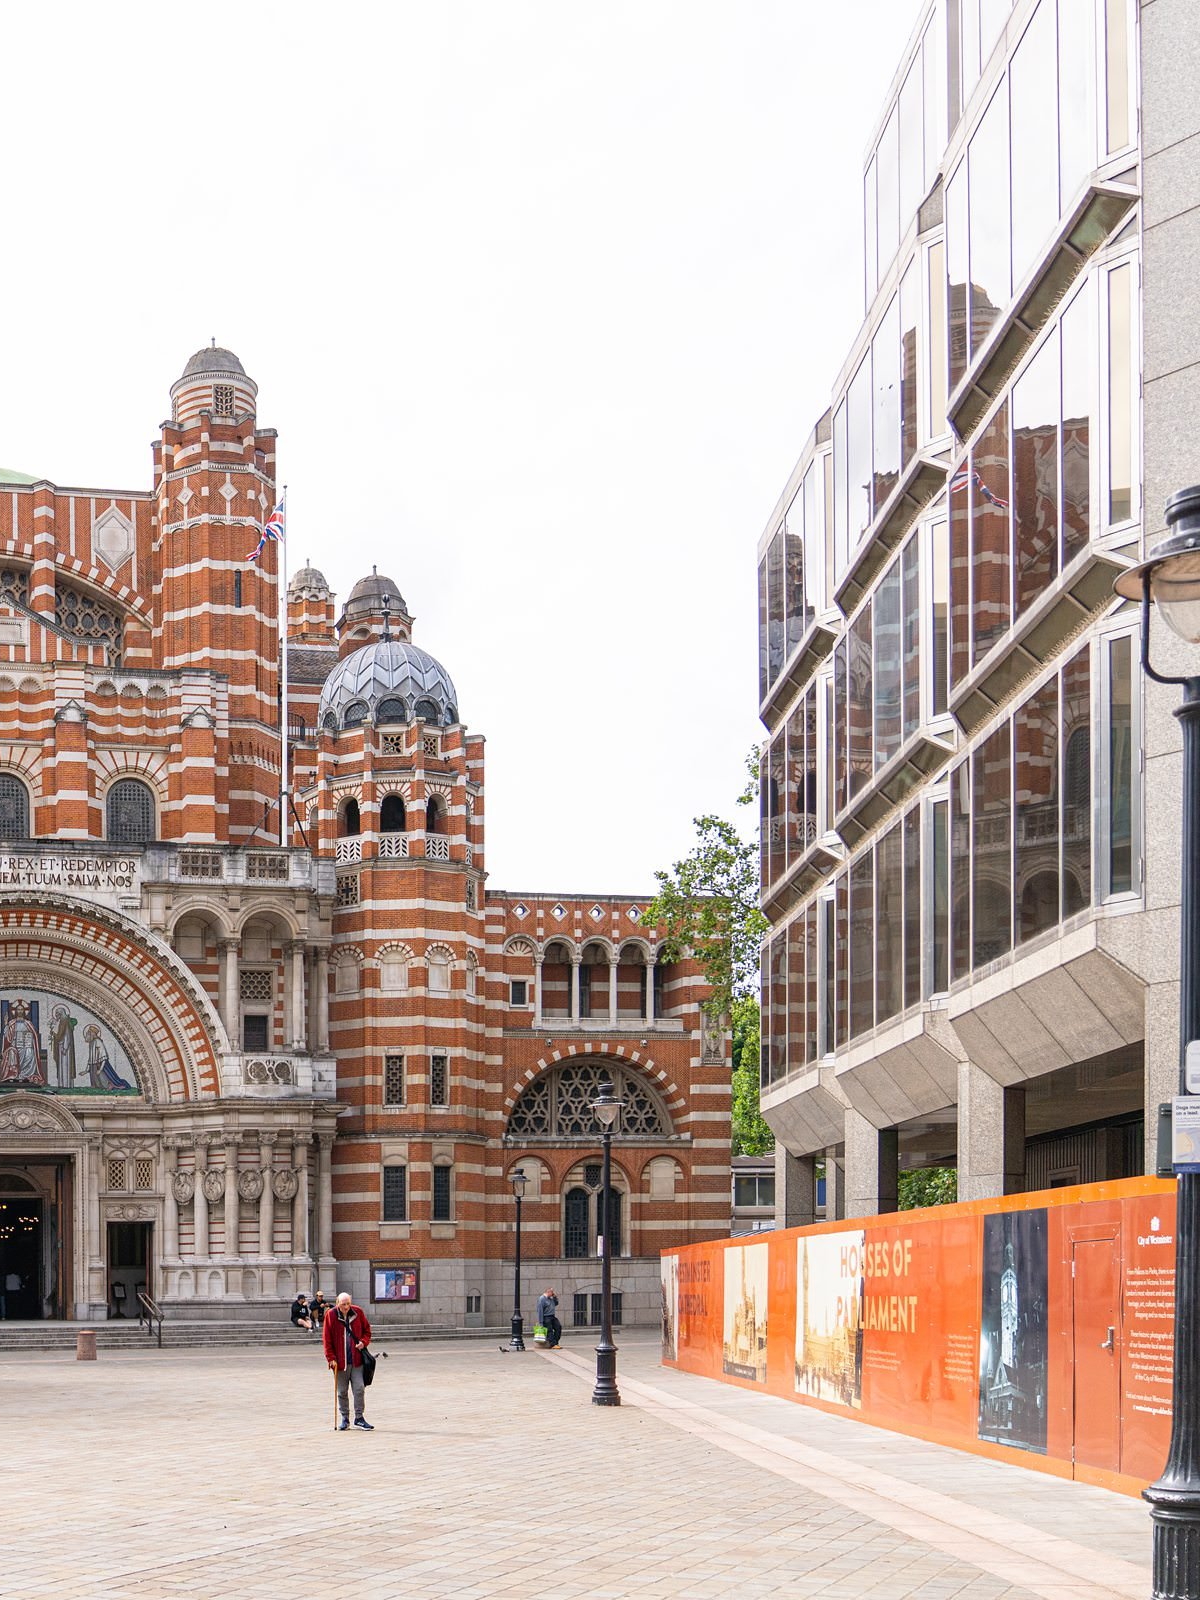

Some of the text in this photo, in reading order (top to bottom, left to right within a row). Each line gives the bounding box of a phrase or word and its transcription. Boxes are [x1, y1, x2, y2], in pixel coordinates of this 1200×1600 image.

[9, 857, 34, 870] REX
[40, 858, 56, 870] ET
[61, 859, 136, 873] REDEMPTOR
[25, 872, 61, 885] TUUM
[67, 874, 101, 887] SALVA
[107, 875, 132, 888] NOS
[840, 1239, 913, 1278] HOUSES OF
[836, 1295, 918, 1334] PARLIAMENT
